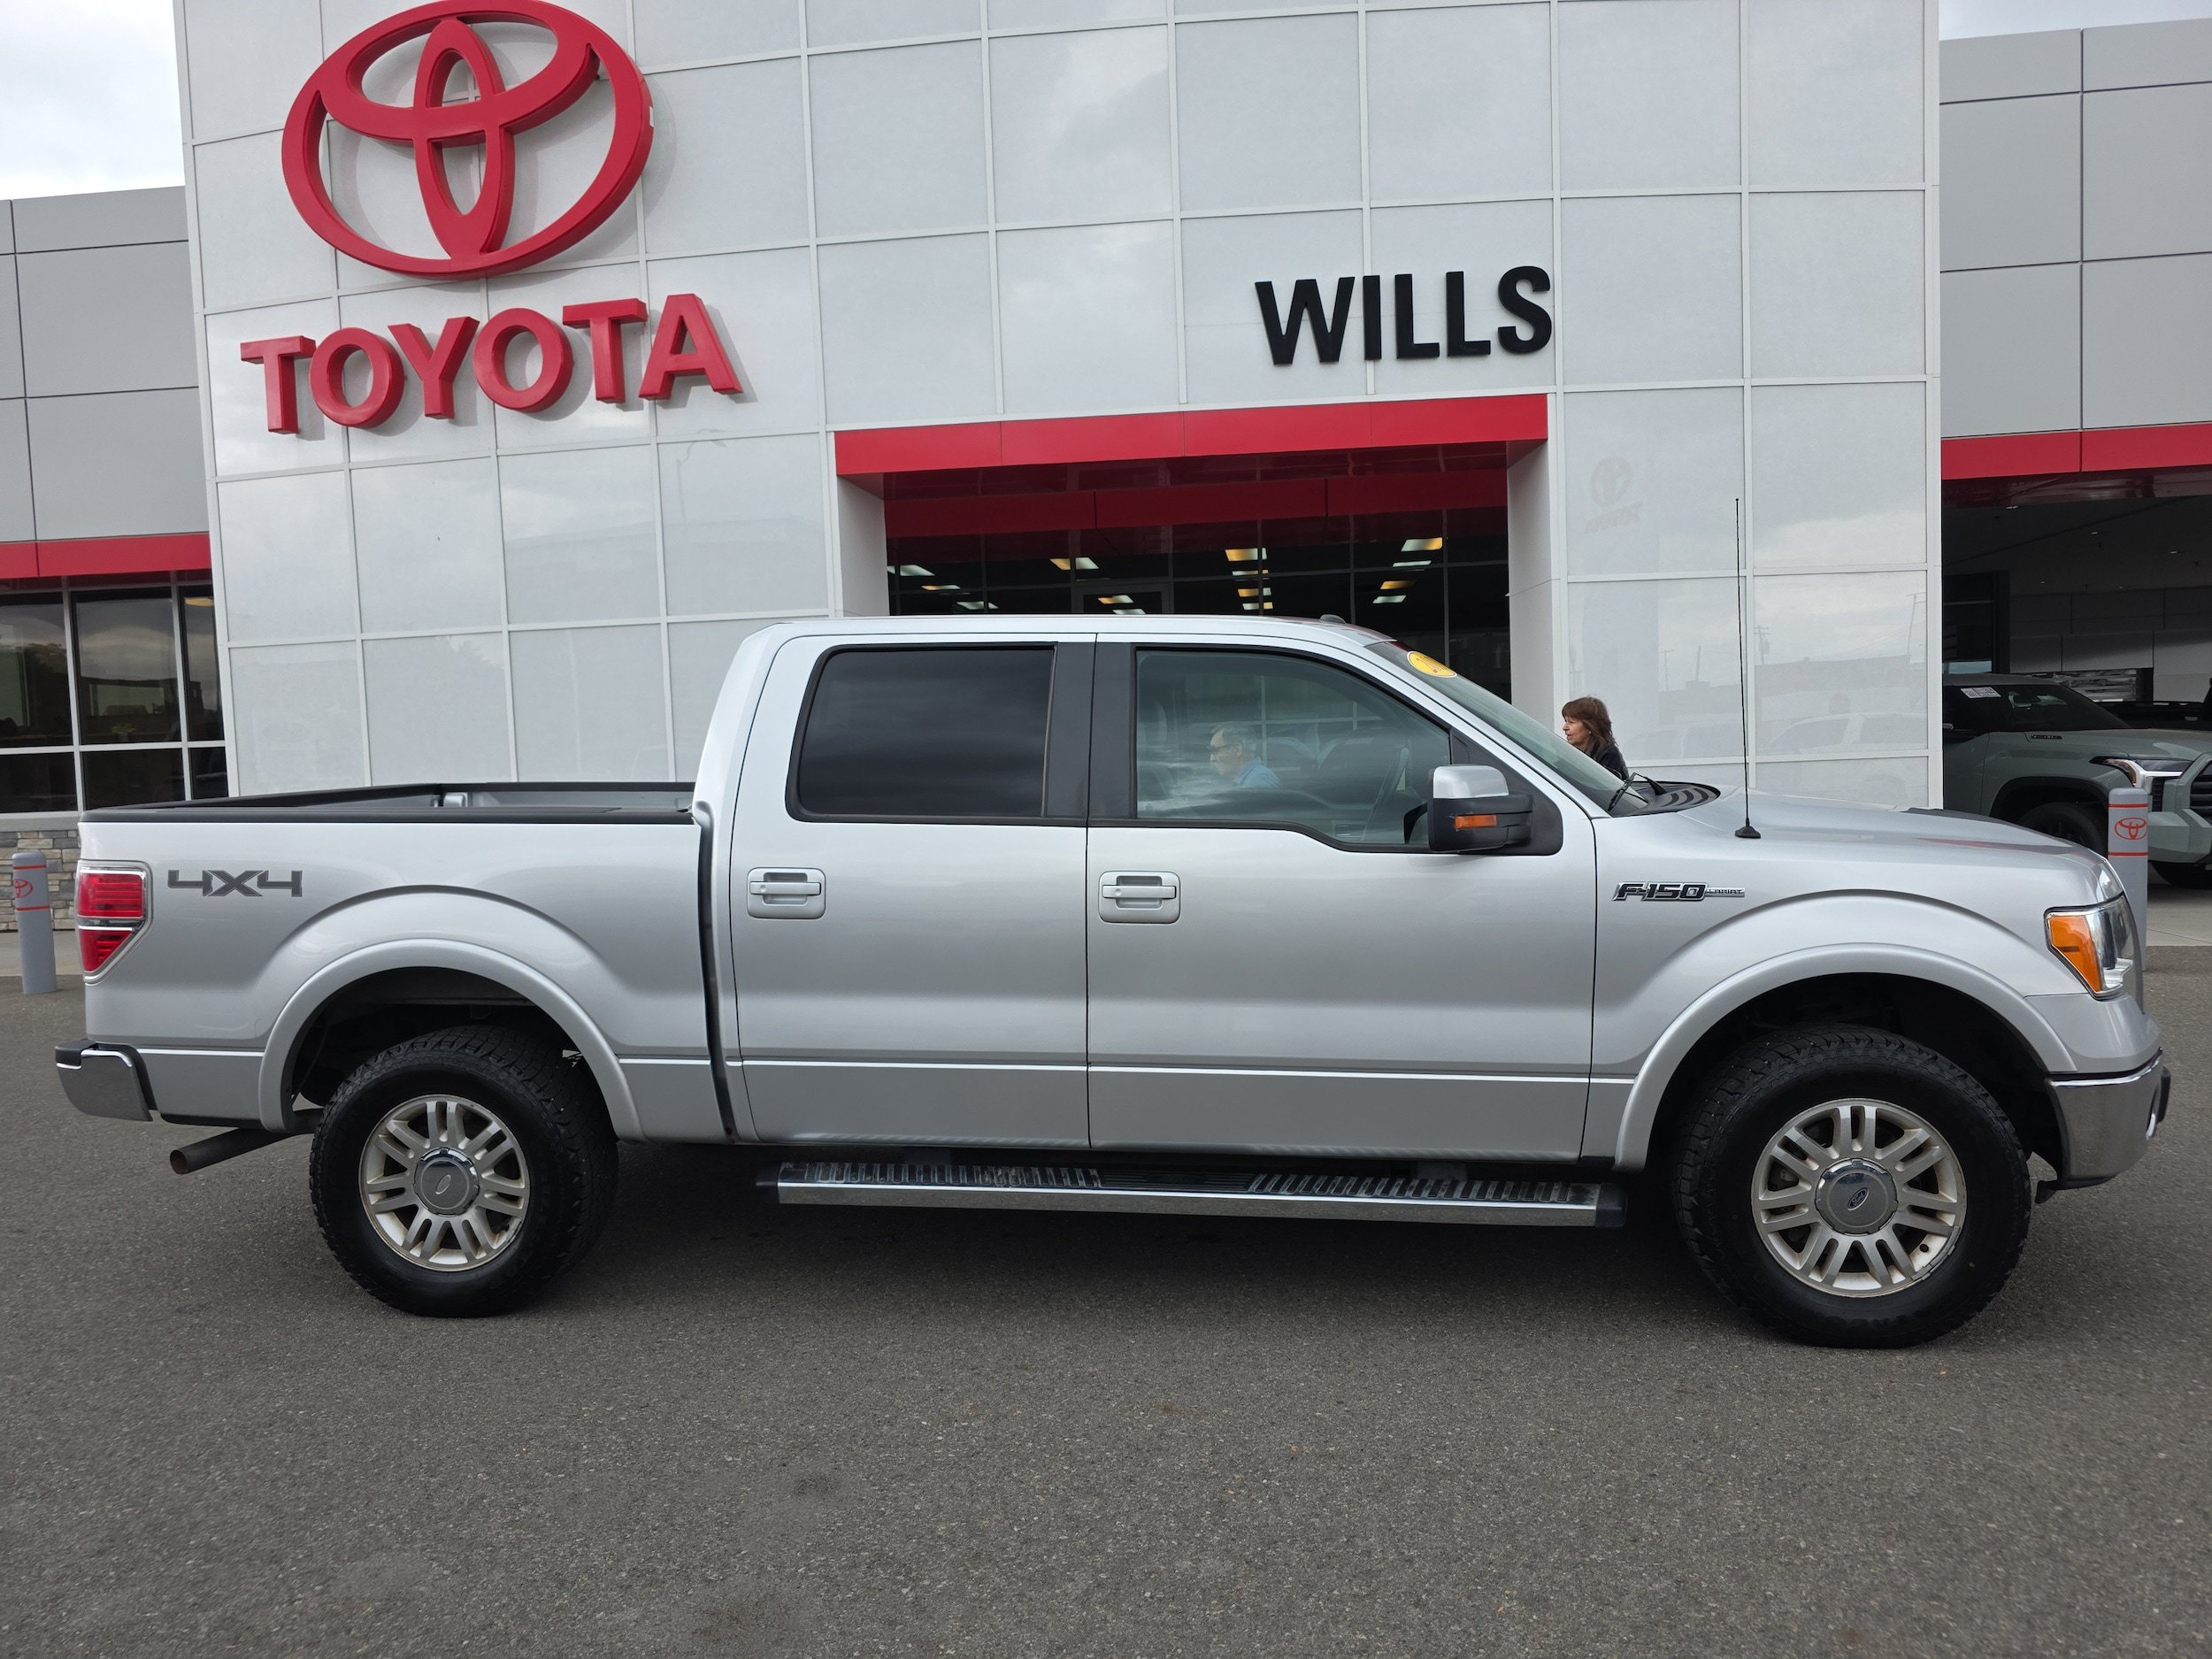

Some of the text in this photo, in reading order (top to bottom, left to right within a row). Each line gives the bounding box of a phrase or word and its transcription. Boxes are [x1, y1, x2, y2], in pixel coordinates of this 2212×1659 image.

[1255, 265, 1553, 365] WILLS
[241, 294, 743, 434] TOYOTA
[167, 870, 303, 897] 4X4
[1613, 881, 1708, 901] F-150
